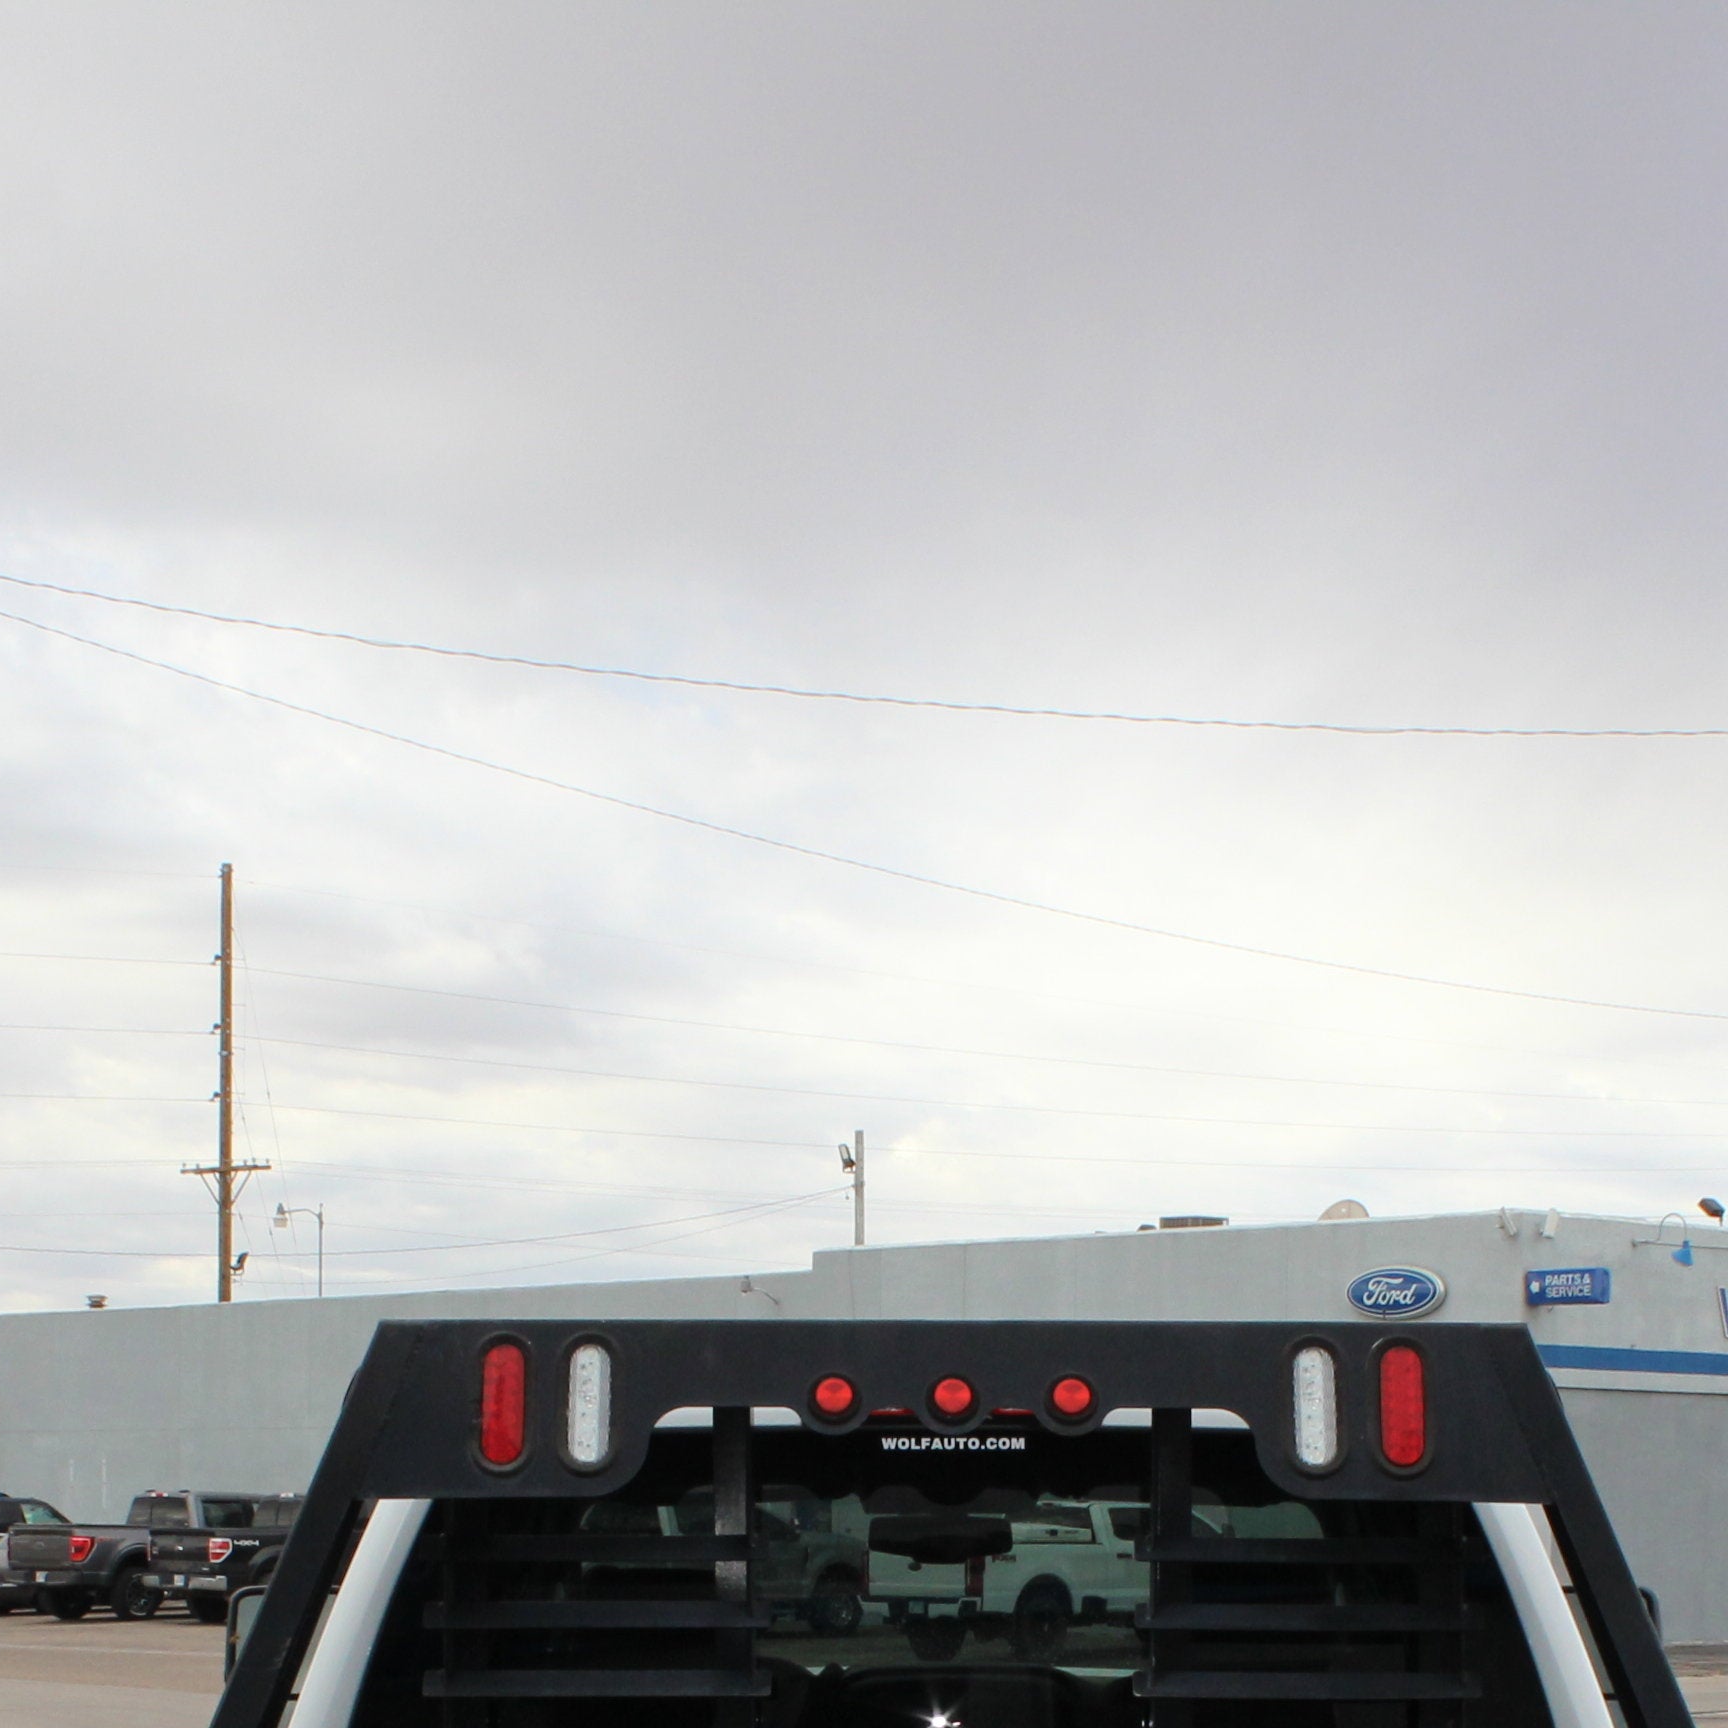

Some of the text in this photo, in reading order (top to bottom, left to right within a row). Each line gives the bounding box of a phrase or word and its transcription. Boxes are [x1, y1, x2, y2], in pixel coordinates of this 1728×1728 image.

[1545, 1273, 1581, 1286] PARTS
[1363, 1276, 1416, 1306] Ford
[1545, 1285, 1591, 1298] SERVICE
[881, 1437, 1026, 1450] WOLFAUTO.COM
